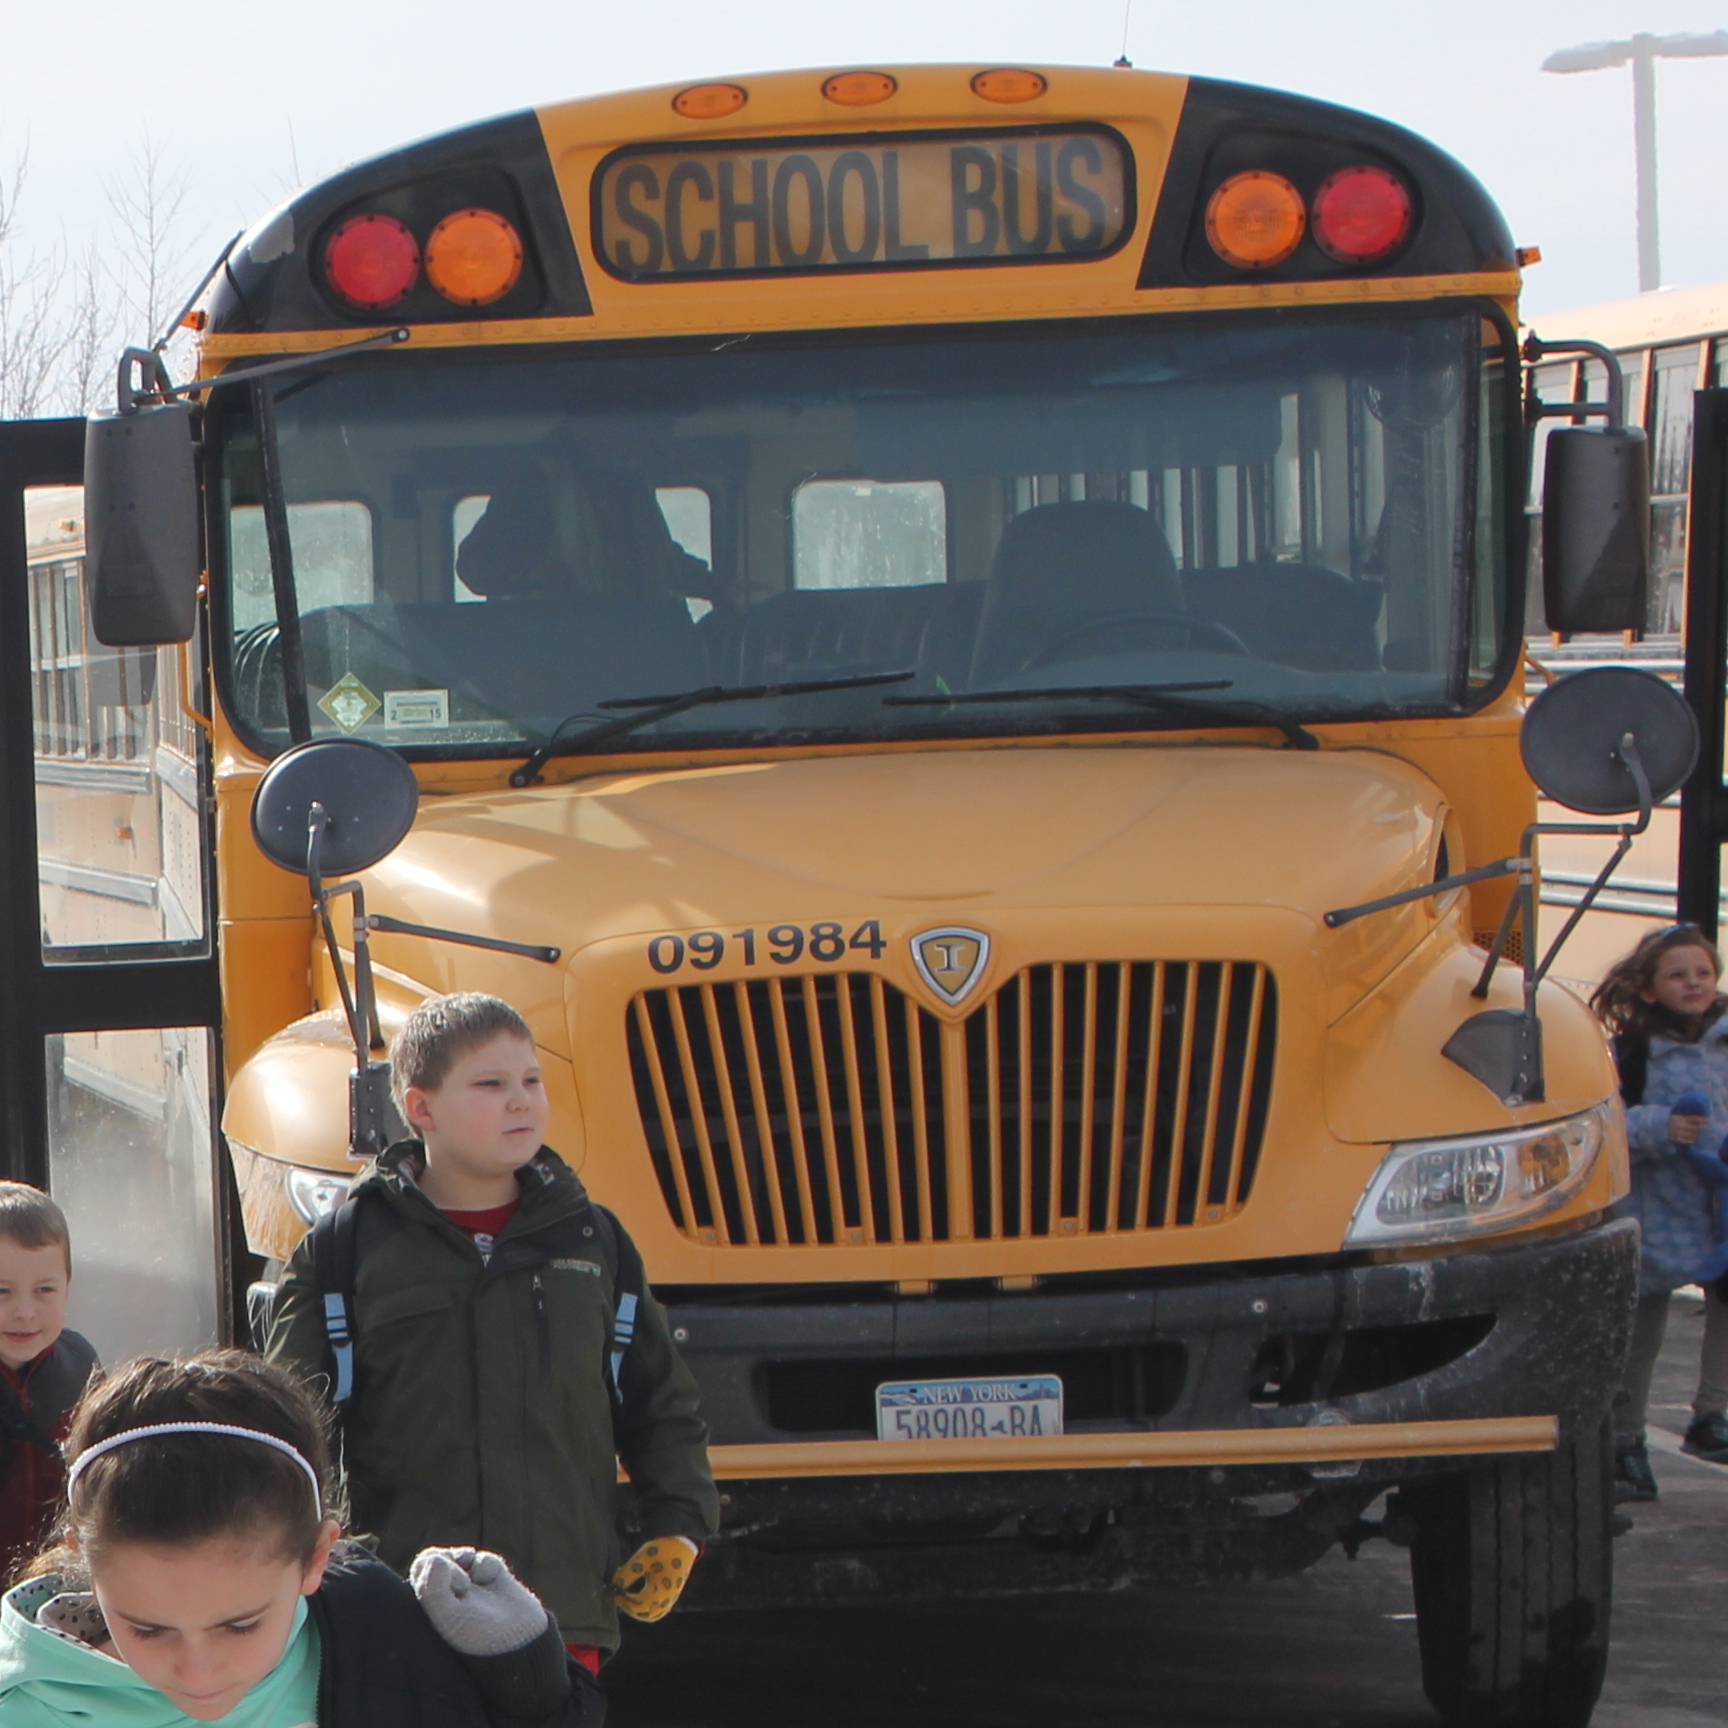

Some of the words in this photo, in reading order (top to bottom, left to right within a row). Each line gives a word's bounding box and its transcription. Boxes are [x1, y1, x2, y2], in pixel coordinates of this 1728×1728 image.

[614, 149, 930, 274] SCHOOL
[950, 138, 1107, 257] BUS
[648, 920, 887, 975] 091984
[923, 1386, 964, 1403] NEW
[968, 1383, 1017, 1401] YORK
